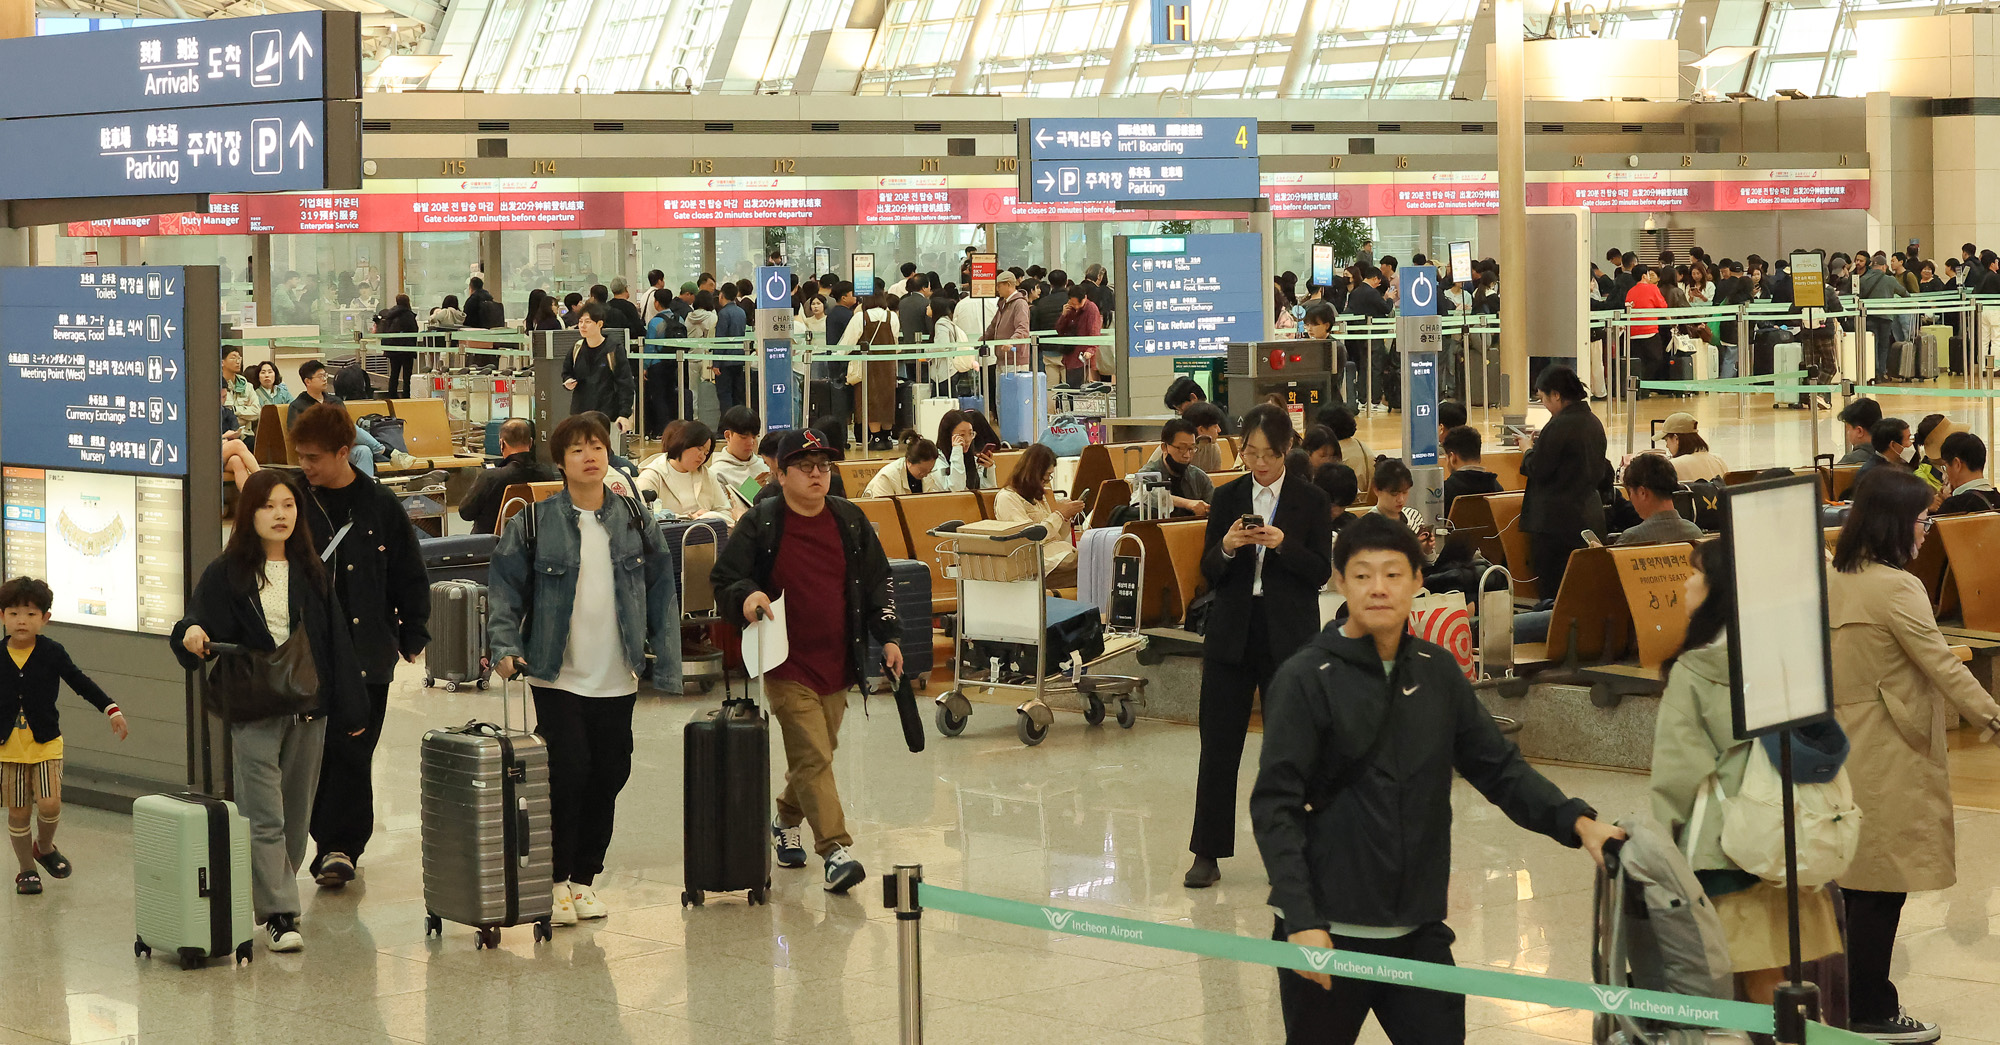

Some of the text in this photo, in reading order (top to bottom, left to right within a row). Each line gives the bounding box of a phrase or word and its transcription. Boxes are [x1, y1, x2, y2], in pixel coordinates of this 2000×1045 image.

[1168, 5, 1190, 41] H
[208, 44, 241, 79] 도착
[144, 69, 200, 96] Arrivals
[1056, 131, 1113, 148] 국제선탑승
[1235, 125, 1248, 150] 4
[186, 131, 242, 167] 주차장
[259, 127, 277, 167] P
[1139, 140, 1184, 154] Boarding
[691, 160, 713, 173] J13
[773, 159, 796, 173] J12
[920, 158, 940, 171] J11
[996, 158, 1017, 171] J10
[1331, 157, 1342, 169] J7
[1396, 156, 1408, 168] J6
[1573, 155, 1585, 167] J4
[1681, 155, 1692, 167] J3
[1738, 155, 1749, 166] J2
[1839, 154, 1848, 166] J1
[126, 155, 179, 184] Parking
[442, 160, 466, 175] J15
[532, 160, 557, 174] J14
[1064, 172, 1077, 192] P
[1085, 172, 1123, 190] 주차장
[1128, 181, 1166, 197] Parking
[299, 197, 359, 209] 기업회원 카운터
[894, 192, 911, 202] 20분
[912, 192, 919, 202] 전
[920, 192, 934, 202] 탑승
[935, 192, 949, 202] 마감
[431, 202, 449, 212] 20분
[451, 202, 459, 212] 전
[461, 202, 476, 212] 탑승
[478, 202, 494, 212] 마감
[680, 199, 697, 209] 20분
[699, 199, 706, 209] 전
[708, 199, 722, 209] 탑승
[724, 199, 738, 209] 마감
[1011, 207, 1027, 215] Gate
[1028, 206, 1048, 214] closes
[1049, 206, 1057, 214] 20
[1057, 206, 1083, 214] minutes
[1083, 205, 1104, 214] before
[1283, 202, 1332, 212] before departure
[1406, 201, 1419, 209] Gate
[1445, 200, 1467, 208] minutes
[1468, 200, 1485, 208] before
[424, 213, 575, 223] Gate closes 20 minutes before departure
[674, 210, 813, 220] Gate closes 20 minutes before departure
[938, 214, 962, 222] departure
[91, 218, 151, 228] Duty Manager
[181, 216, 240, 228] Duty Manager
[300, 222, 360, 231] Enterprise Service
[119, 277, 144, 294] 화장실
[95, 288, 117, 299] Toilets
[127, 320, 144, 337] 식사
[1157, 322, 1170, 331] Tax
[1171, 320, 1196, 330] Refund
[53, 329, 105, 342] Beverages, Food
[20, 367, 86, 382] Meeting Point (West)
[129, 401, 146, 419] 환전
[66, 409, 127, 425] Currency Exchange
[1051, 426, 1078, 434] Merci
[109, 441, 146, 460] 유아휴게실
[80, 450, 106, 465] Nursery
[1640, 573, 1688, 584] PRIORITY SEATS
[1072, 920, 1143, 939] Incheon Airport
[1333, 959, 1413, 981] Incheon Airport
[1629, 999, 1719, 1021] Incheon Airport
